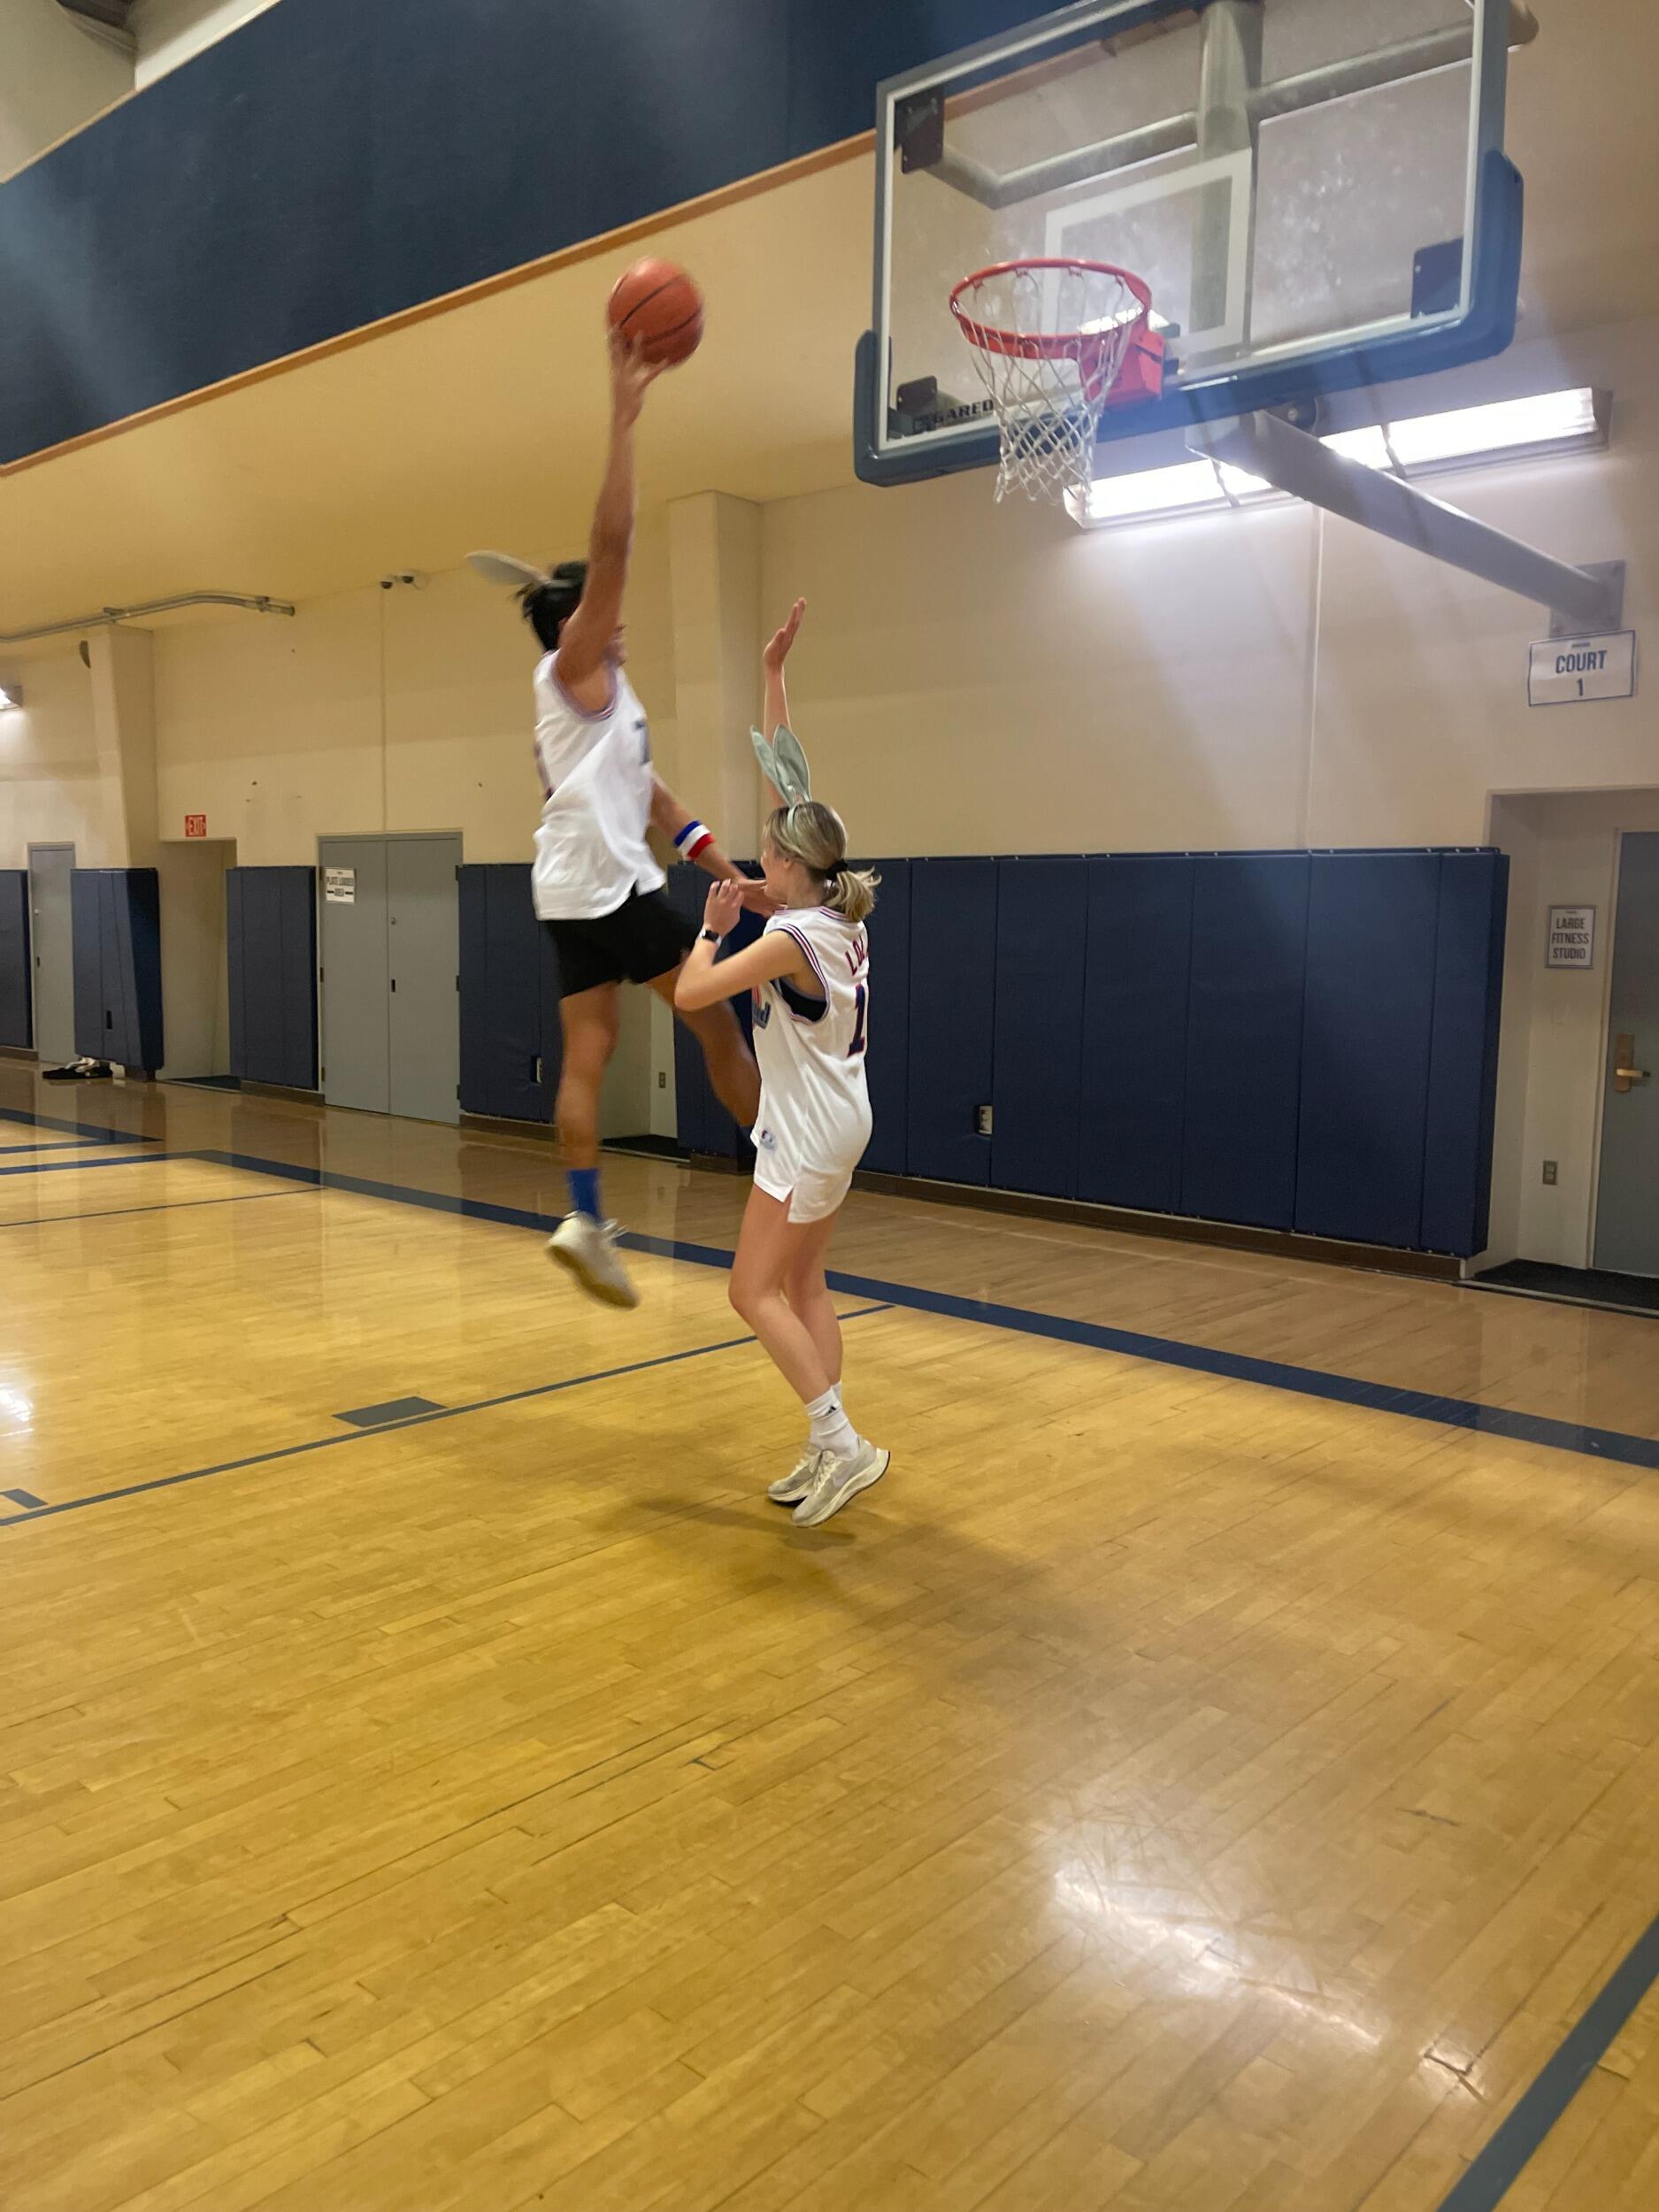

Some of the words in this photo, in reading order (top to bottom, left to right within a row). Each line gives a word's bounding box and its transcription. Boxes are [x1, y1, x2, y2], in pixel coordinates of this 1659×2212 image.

[933, 399, 994, 423] GARED
[1555, 649, 1608, 674] COURT
[1577, 678, 1584, 696] 1
[188, 816, 204, 836] EXIT
[1555, 917, 1586, 929] LARGE
[1551, 933, 1590, 944] FITNESS
[1553, 948, 1586, 959] STUDIO
[847, 983, 865, 1058] 1
